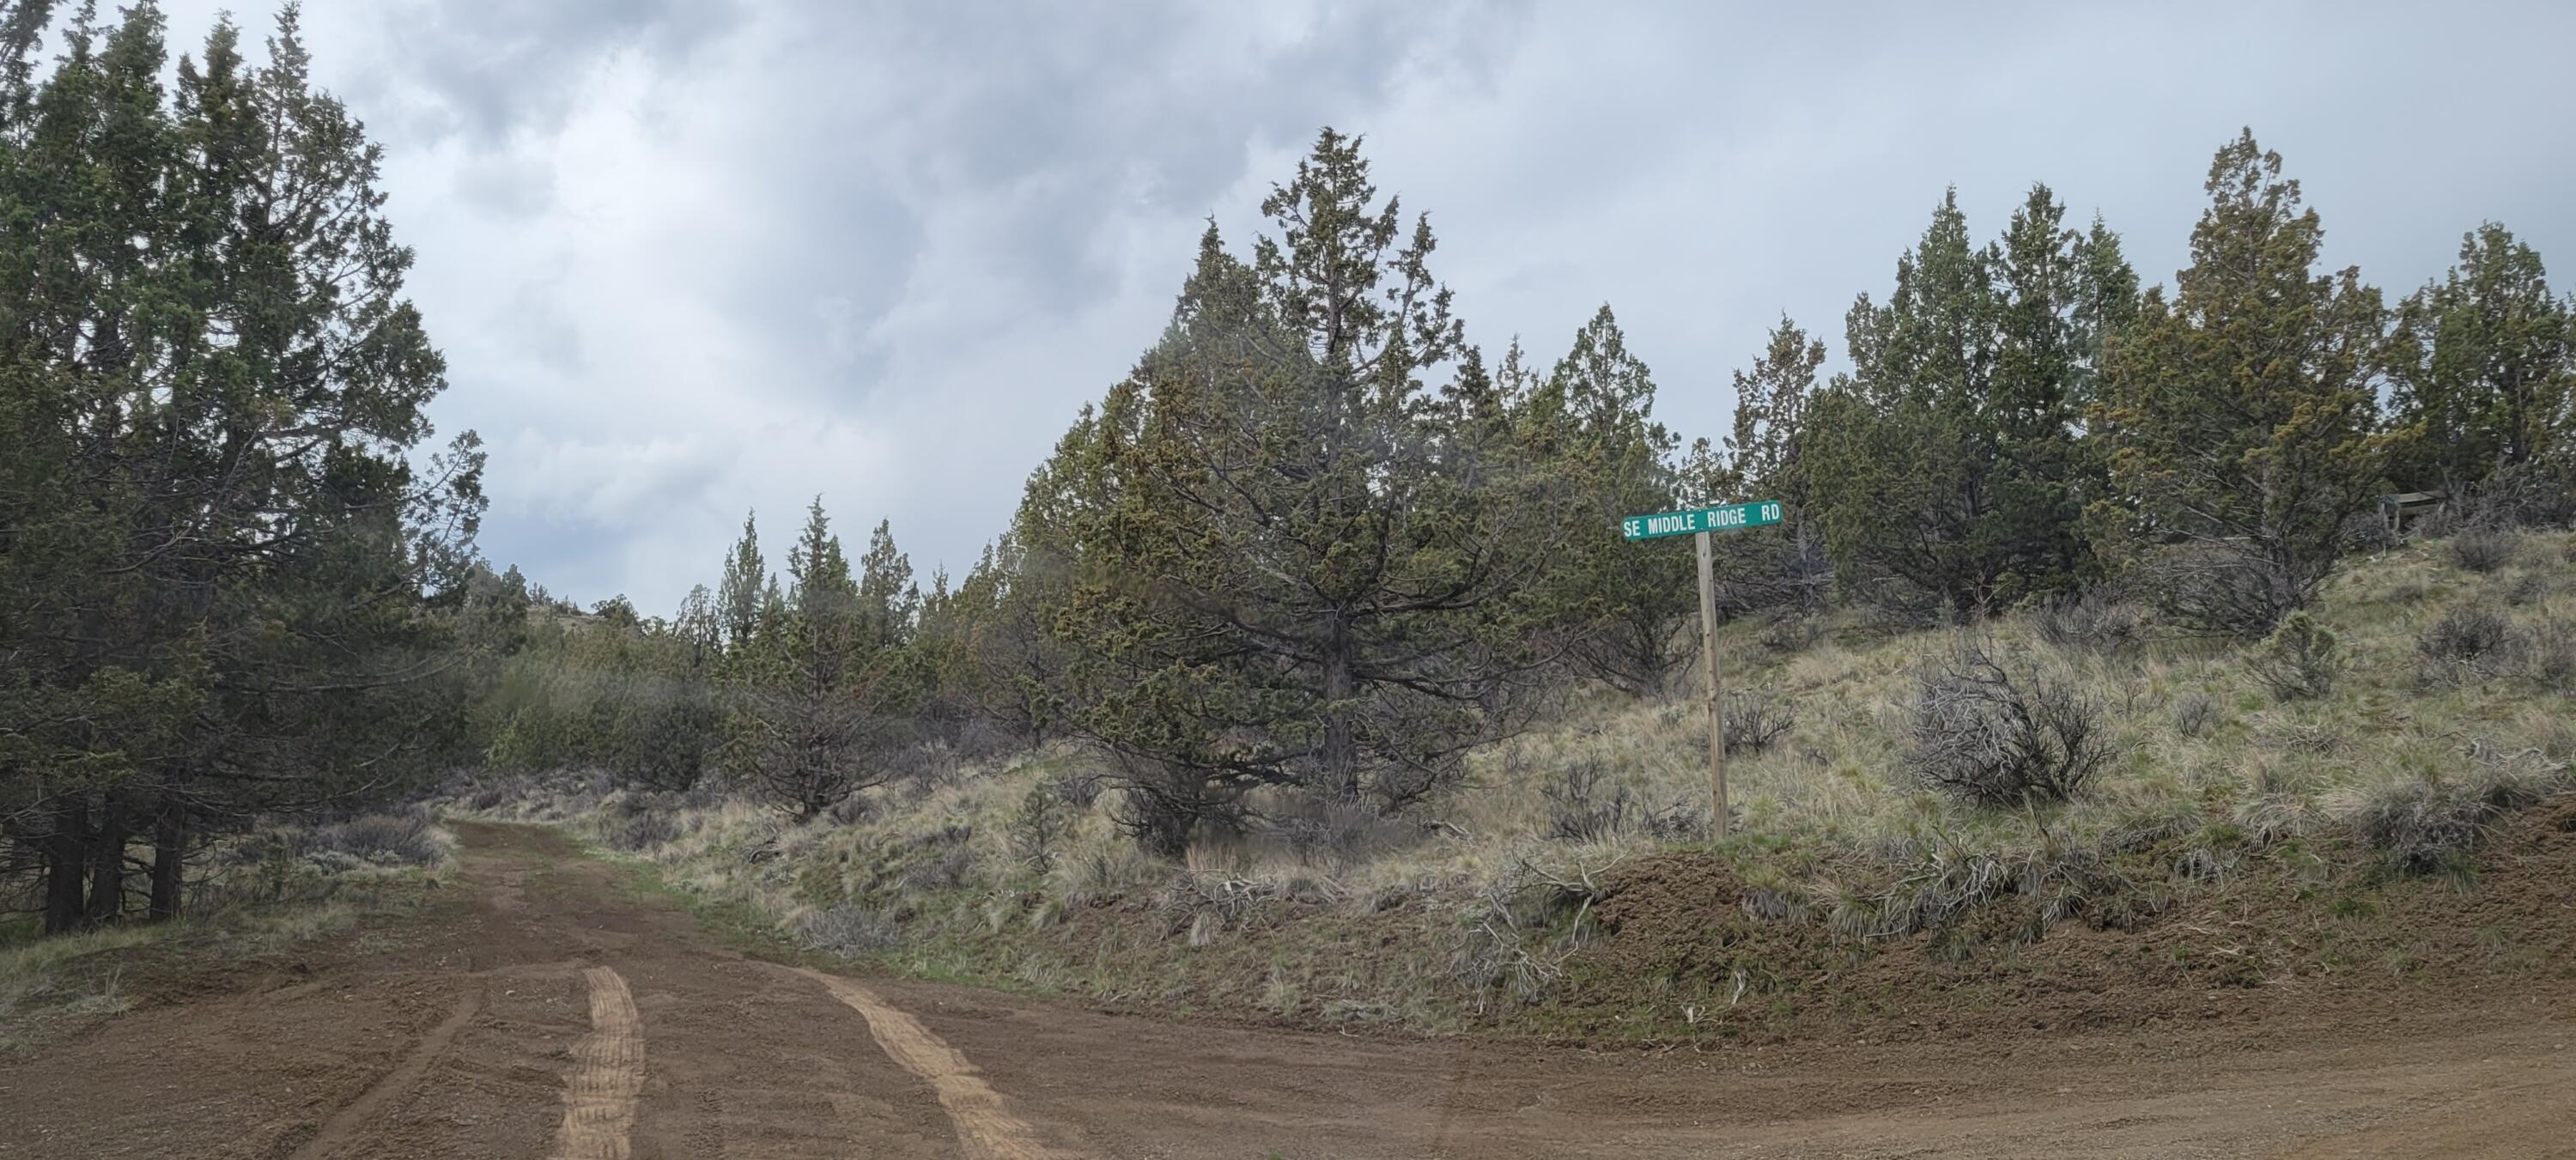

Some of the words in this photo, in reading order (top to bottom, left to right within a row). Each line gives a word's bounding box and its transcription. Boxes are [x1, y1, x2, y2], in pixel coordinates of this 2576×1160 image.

[1624, 520, 1641, 537] SE
[1648, 513, 1696, 534] MIDDLE
[1707, 507, 1747, 527] RIDGE
[1761, 503, 1780, 521] RD
